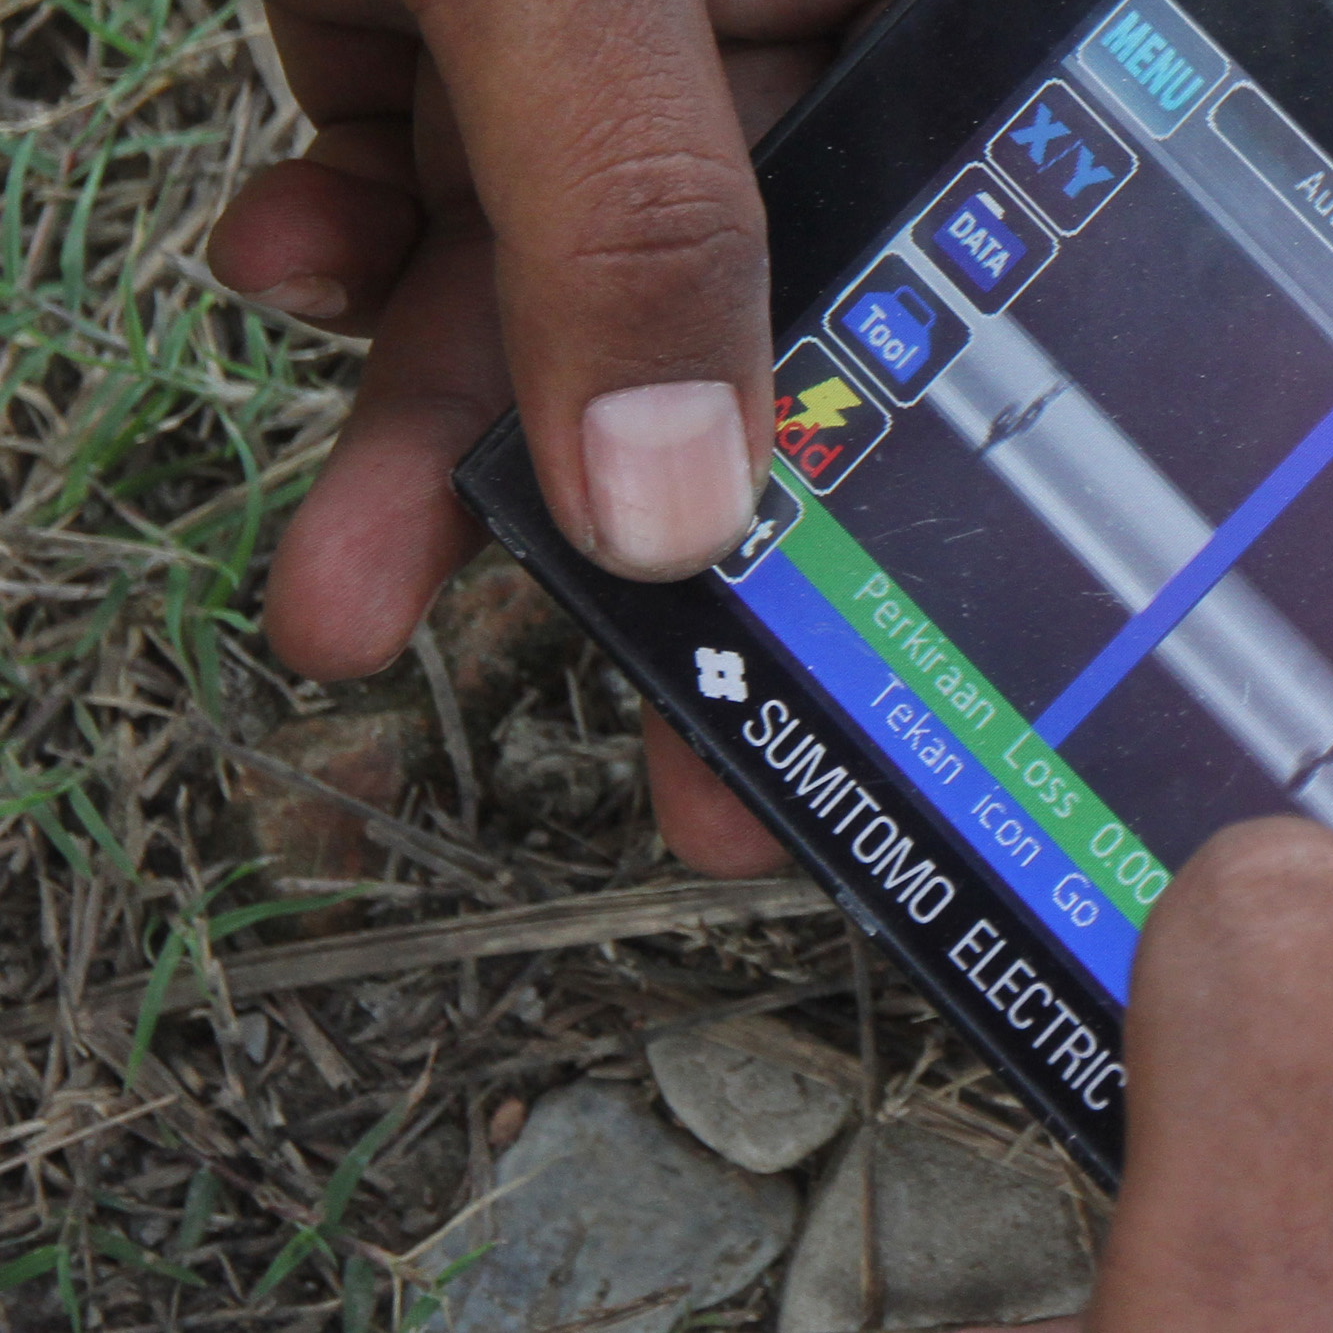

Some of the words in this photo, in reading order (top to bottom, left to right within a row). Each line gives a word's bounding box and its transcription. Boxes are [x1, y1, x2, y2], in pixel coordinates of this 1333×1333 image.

[1101, 11, 1205, 111] MENU
[1009, 102, 1115, 199] X/Y
[948, 211, 1010, 278] DATA
[857, 304, 919, 370] Tool
[854, 572, 995, 729] Perkiraan
[1002, 730, 1080, 819] Loss
[1089, 822, 1169, 906] 0.00
[869, 673, 965, 785] Tekan
[971, 785, 1042, 869] icon
[1052, 872, 1100, 928] Go
[743, 699, 955, 924] SUMITOMO
[948, 919, 1128, 1111] ELECTRIC
